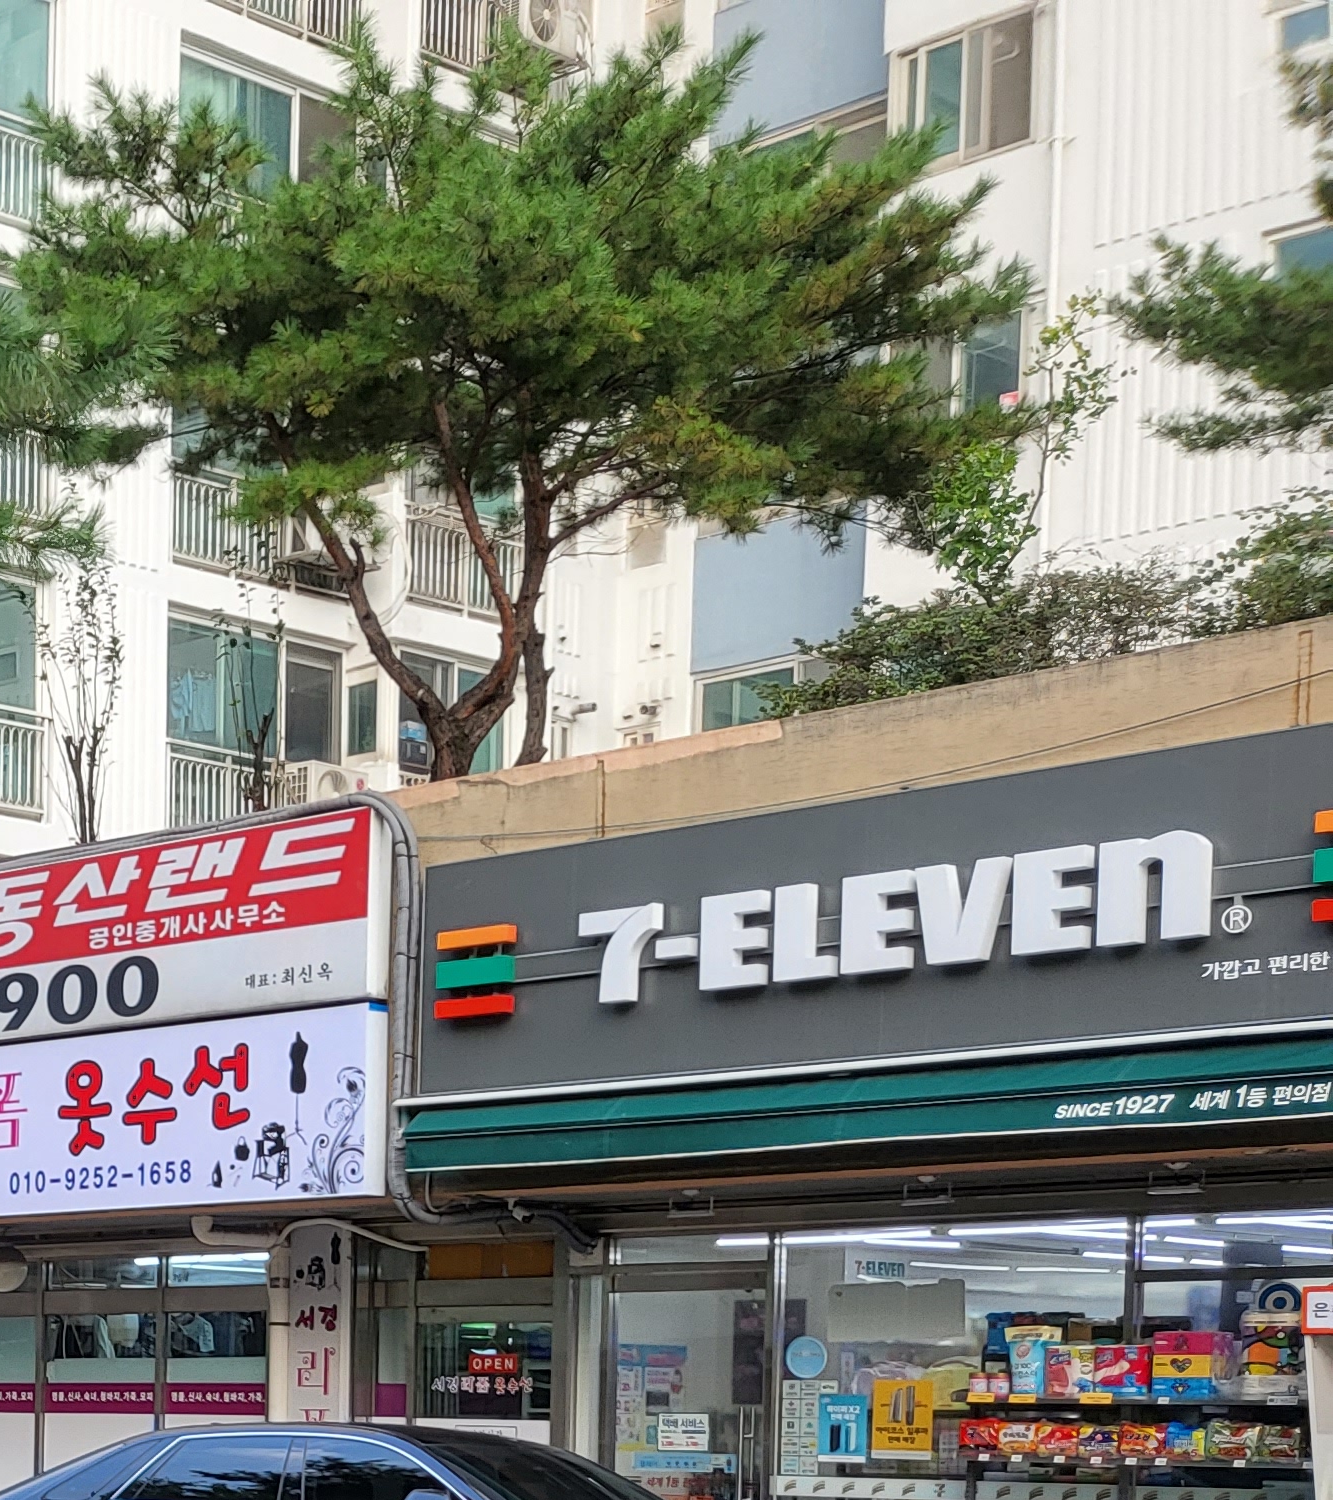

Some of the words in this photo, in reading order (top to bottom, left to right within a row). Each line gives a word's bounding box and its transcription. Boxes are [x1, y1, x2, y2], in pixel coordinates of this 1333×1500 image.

[1200, 958, 1263, 981] 가깝고
[1267, 951, 1331, 976] 편리한
[58, 1042, 251, 1157] 옷수선
[1189, 1089, 1231, 1112] 세계
[1235, 1084, 1268, 1109] 1등
[1272, 1081, 1332, 1105] 편의점
[8, 1159, 193, 1196] 010-9252-1658
[294, 1303, 338, 1332] 서경
[472, 1358, 513, 1370] OPEN
